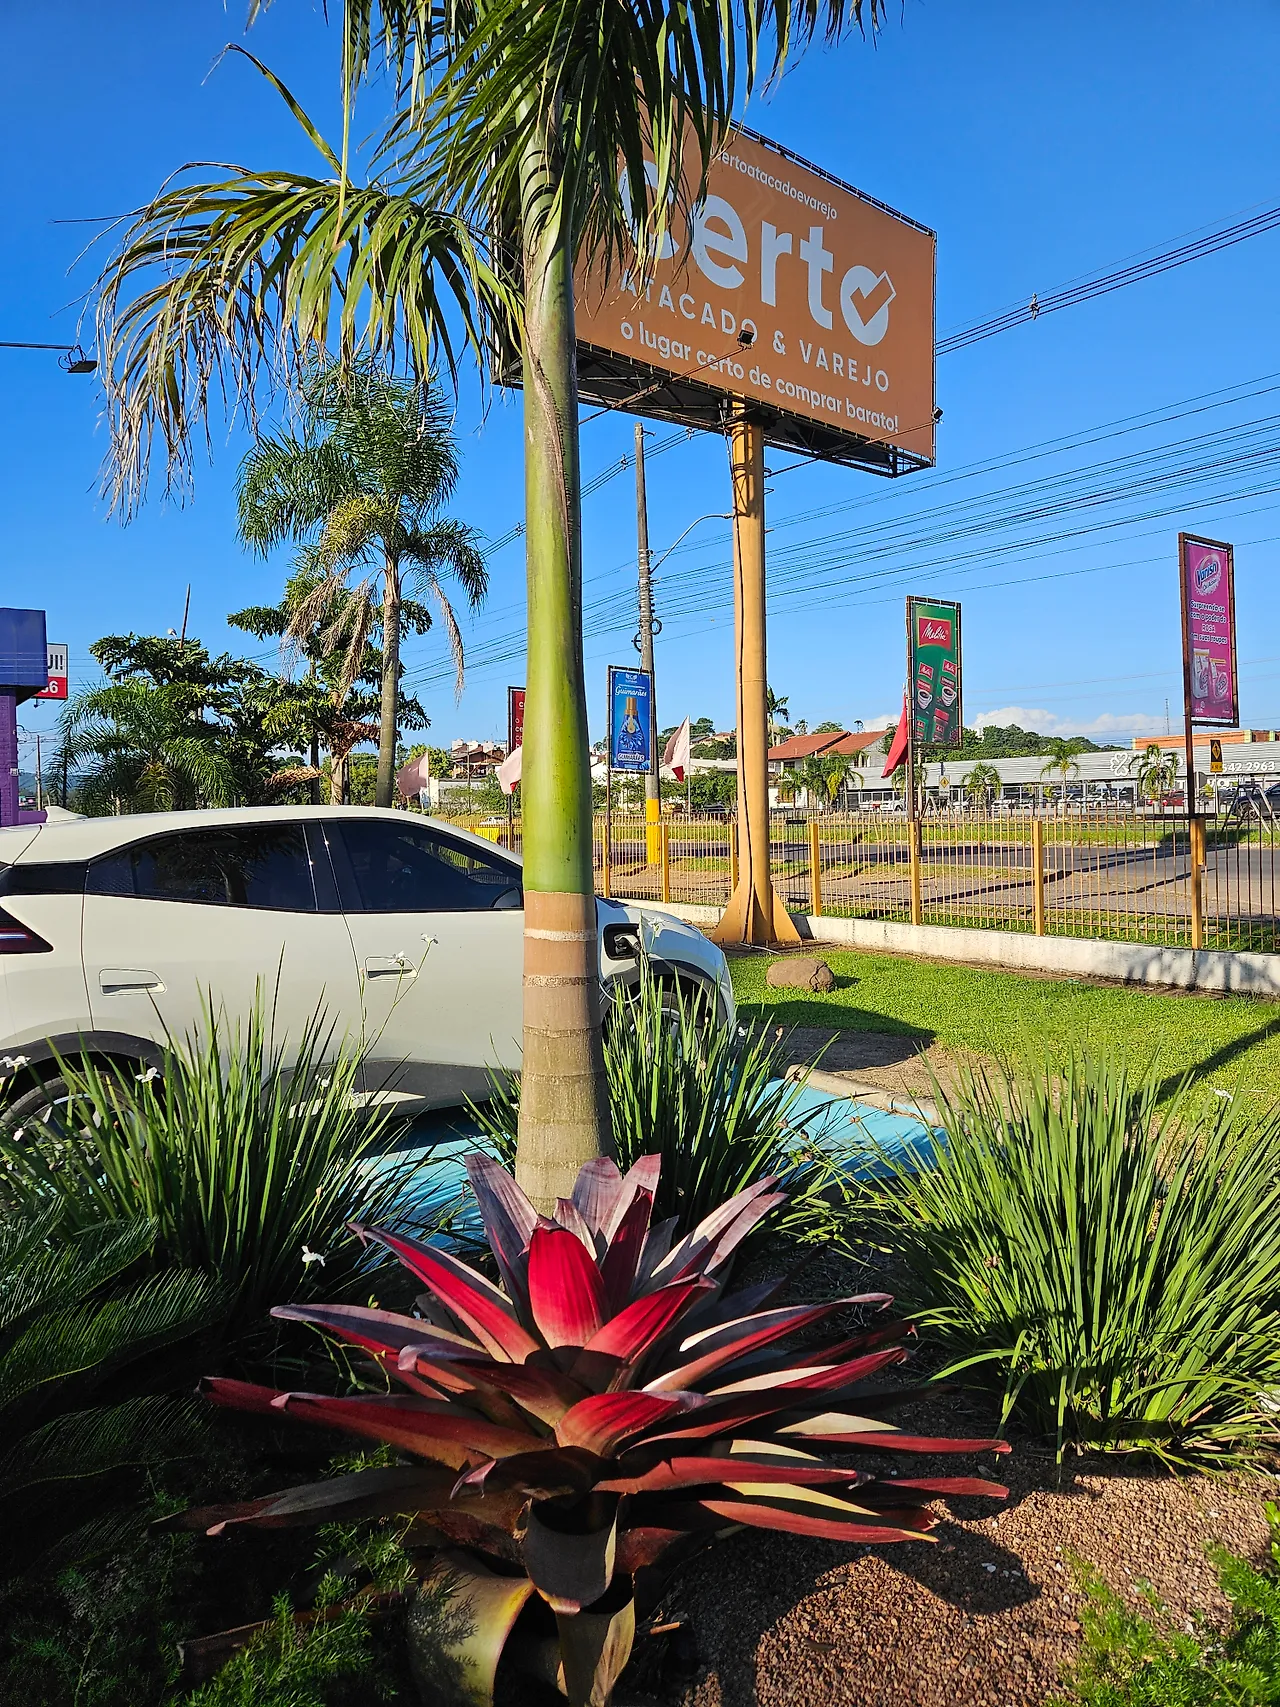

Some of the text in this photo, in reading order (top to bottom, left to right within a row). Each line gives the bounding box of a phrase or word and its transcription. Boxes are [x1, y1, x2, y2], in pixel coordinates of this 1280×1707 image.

[620, 321, 899, 433] o lugar certo de comprar barato!
[773, 330, 786, 355] &
[799, 339, 889, 392] VAREJO
